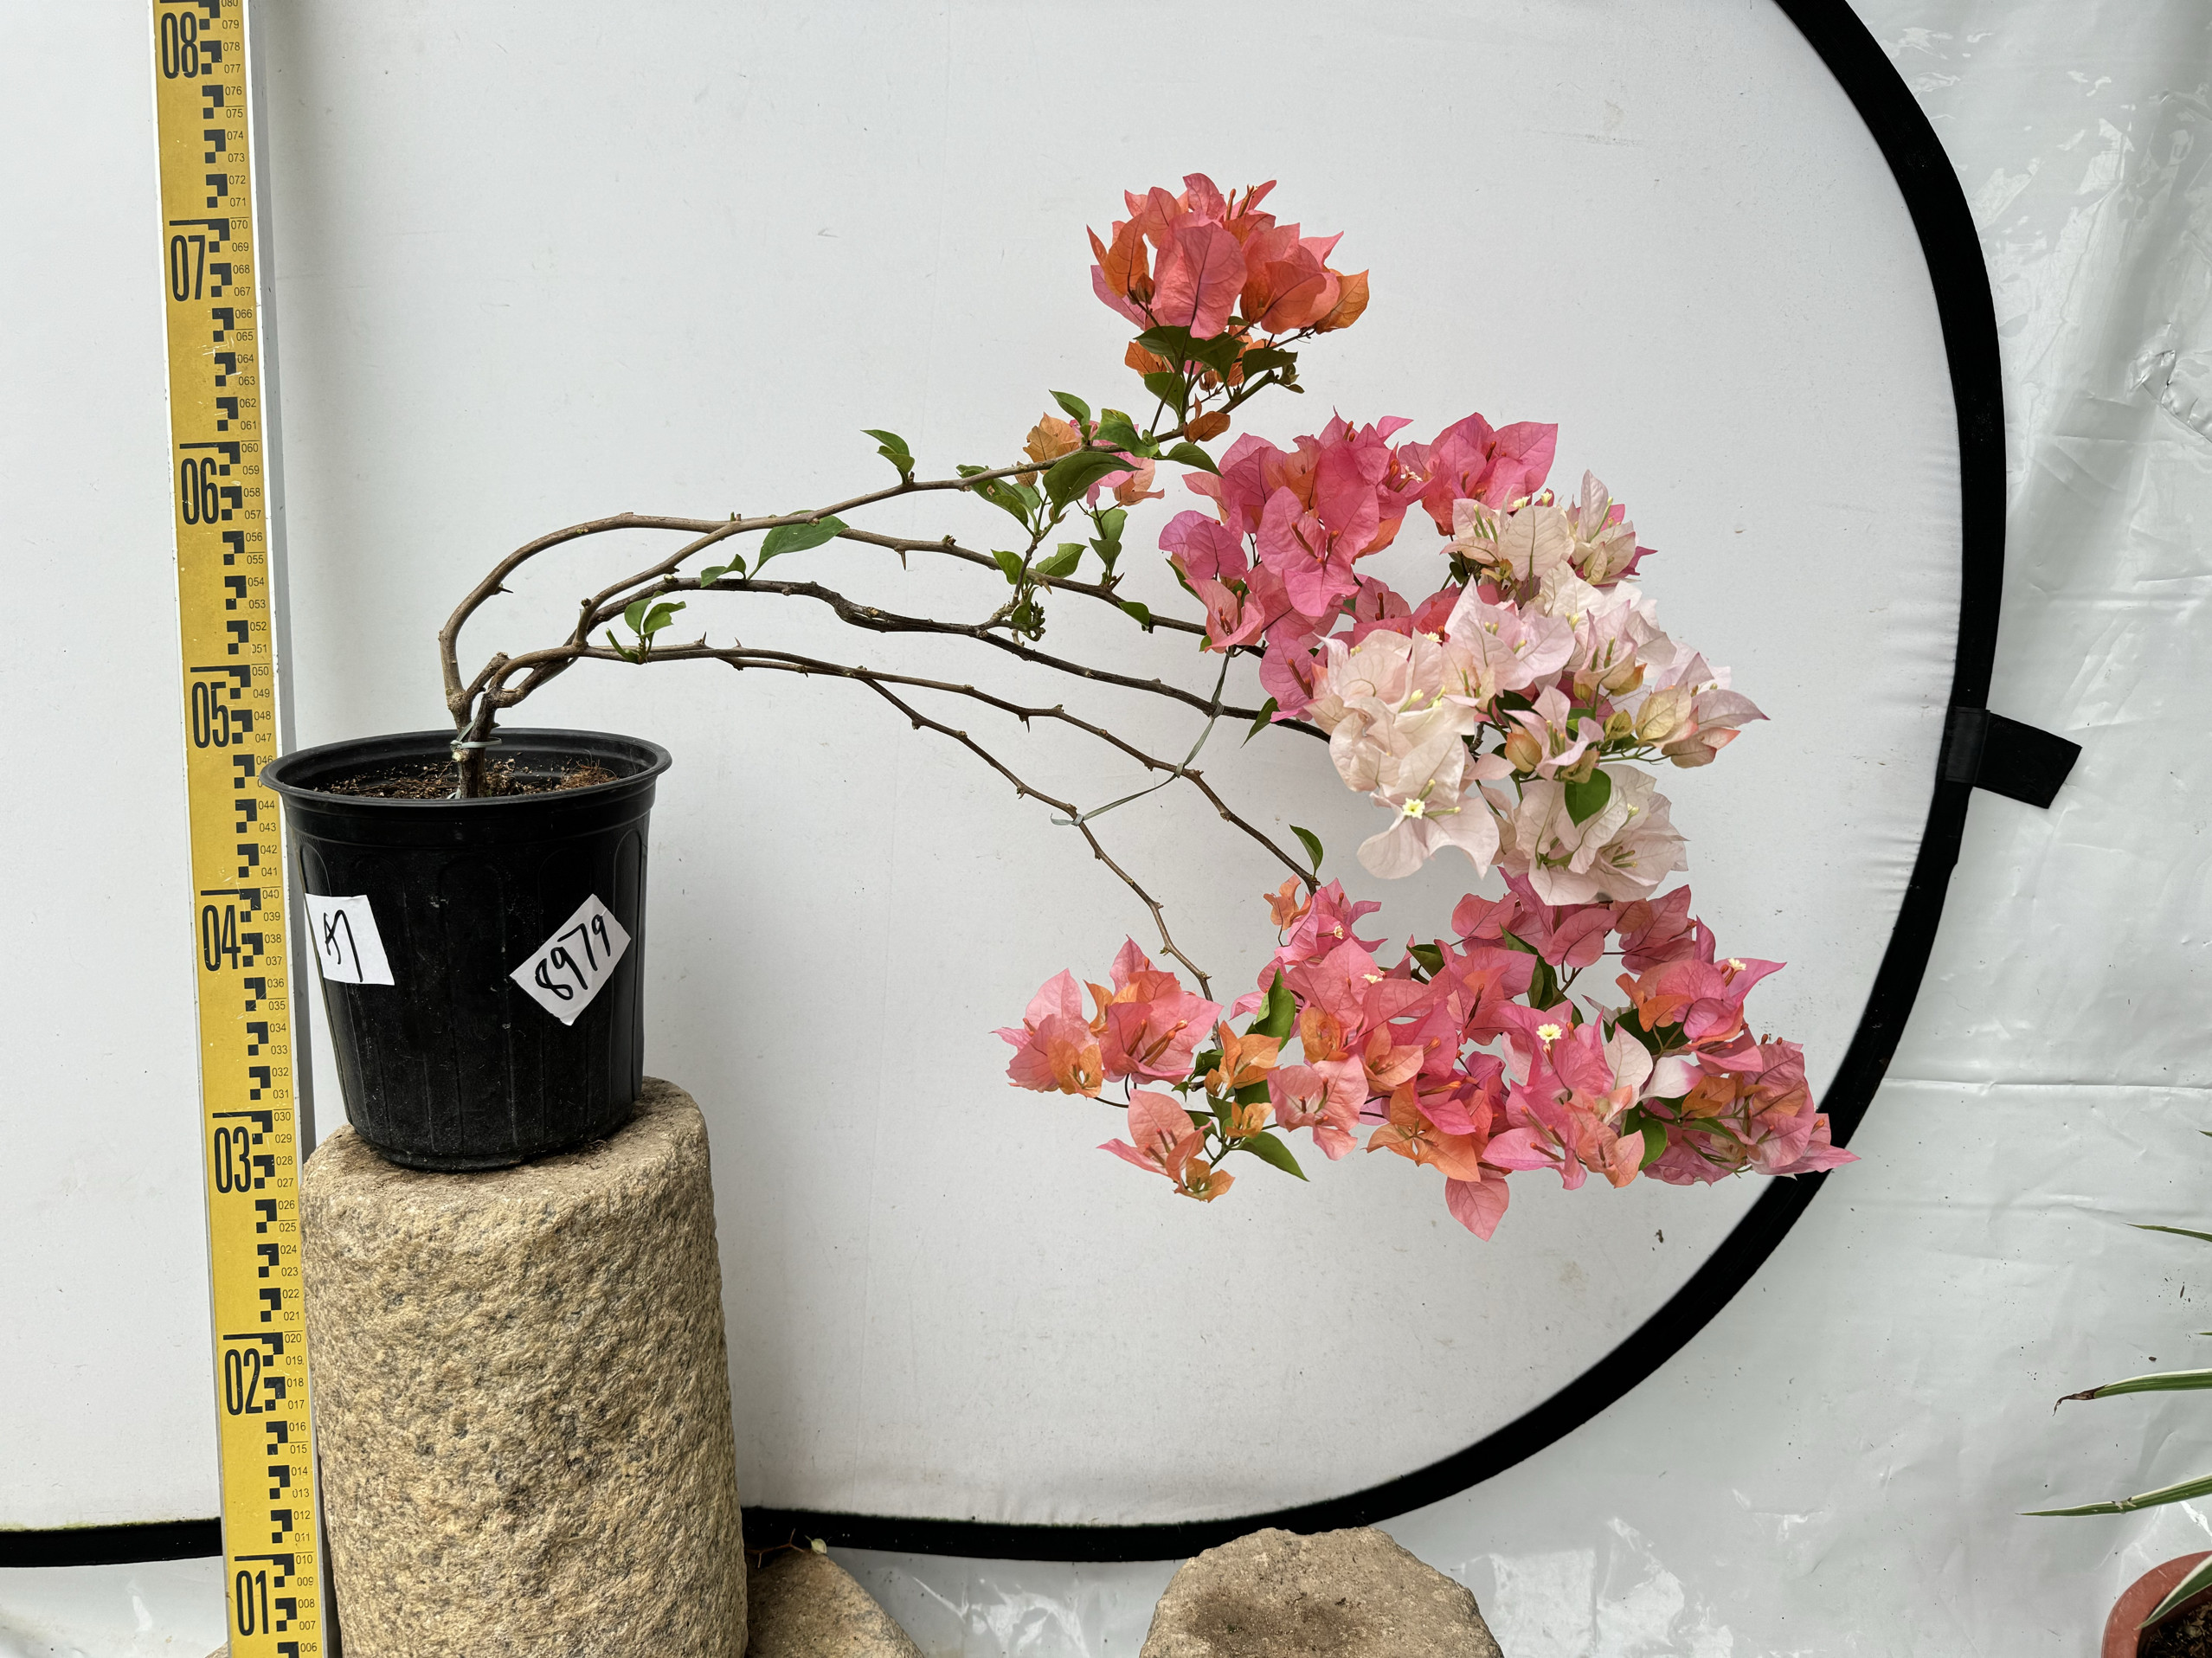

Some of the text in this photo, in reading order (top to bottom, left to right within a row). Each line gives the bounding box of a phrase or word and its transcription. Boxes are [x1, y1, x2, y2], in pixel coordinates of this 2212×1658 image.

[222, 19, 240, 29] 079
[161, 11, 198, 79] 08
[222, 41, 241, 52] 078
[223, 63, 241, 74] 077
[224, 85, 242, 96] 076
[226, 108, 243, 119] 075
[227, 130, 244, 141] 074
[228, 152, 245, 163] 073
[228, 174, 247, 185] 072
[229, 196, 247, 208] 071
[230, 219, 248, 230] 070
[231, 241, 249, 253] 069
[170, 235, 205, 302] 07
[232, 264, 251, 275] 068
[234, 286, 251, 297] 067
[235, 308, 253, 319] 066
[235, 331, 254, 342] 065
[236, 353, 254, 364] 064
[238, 376, 256, 386] 063
[239, 397, 257, 408] 062
[240, 420, 257, 431] 061
[241, 442, 259, 453] 060
[242, 465, 260, 476] 059
[181, 457, 219, 524] 06
[243, 486, 261, 498] 058
[244, 509, 261, 520] 057
[245, 531, 263, 543] 056
[246, 554, 264, 565] 055
[248, 576, 265, 588] 054
[248, 599, 267, 609] 053
[249, 620, 267, 632] 052
[251, 665, 269, 677] 050
[253, 688, 271, 699] 049
[191, 681, 229, 749] 05
[254, 710, 272, 721] 048
[254, 732, 272, 743] 047
[255, 755, 273, 766] 046
[258, 800, 275, 811] 044
[259, 822, 277, 832] 043
[260, 845, 278, 855] 042
[260, 866, 278, 877] 041
[261, 889, 280, 900] 040
[263, 911, 281, 922] 039
[202, 904, 241, 972] 04
[264, 933, 282, 944] 038
[265, 955, 283, 967] 037
[534, 914, 611, 1001] 8979
[267, 977, 285, 988] 036
[268, 999, 286, 1011] 035
[269, 1022, 286, 1033] 034
[270, 1044, 288, 1056] 033
[271, 1066, 289, 1077] 032
[273, 1089, 289, 1100] 031
[273, 1111, 292, 1122] 030
[274, 1133, 293, 1144] 029
[214, 1126, 251, 1193] 03
[275, 1155, 293, 1166] 028
[276, 1177, 294, 1188] 027
[278, 1199, 295, 1211] 026
[279, 1222, 297, 1233] 025
[280, 1244, 298, 1255] 024
[280, 1266, 299, 1277] 023
[281, 1288, 300, 1300] 022
[283, 1310, 299, 1321] 021
[284, 1333, 302, 1344] 020
[285, 1354, 303, 1366] 019
[224, 1348, 263, 1416] 02
[286, 1377, 305, 1388] 018
[287, 1398, 305, 1411] 017
[288, 1421, 306, 1432] 016
[289, 1443, 308, 1455] 015
[291, 1466, 308, 1476] 014
[292, 1488, 310, 1499] 013
[293, 1509, 311, 1520] 012
[294, 1532, 310, 1543] 011
[295, 1554, 313, 1565] 010
[296, 1576, 314, 1587] 009
[235, 1570, 269, 1636] 01
[298, 1597, 316, 1609] 008
[299, 1620, 317, 1631] 007
[299, 1642, 318, 1653] 006
